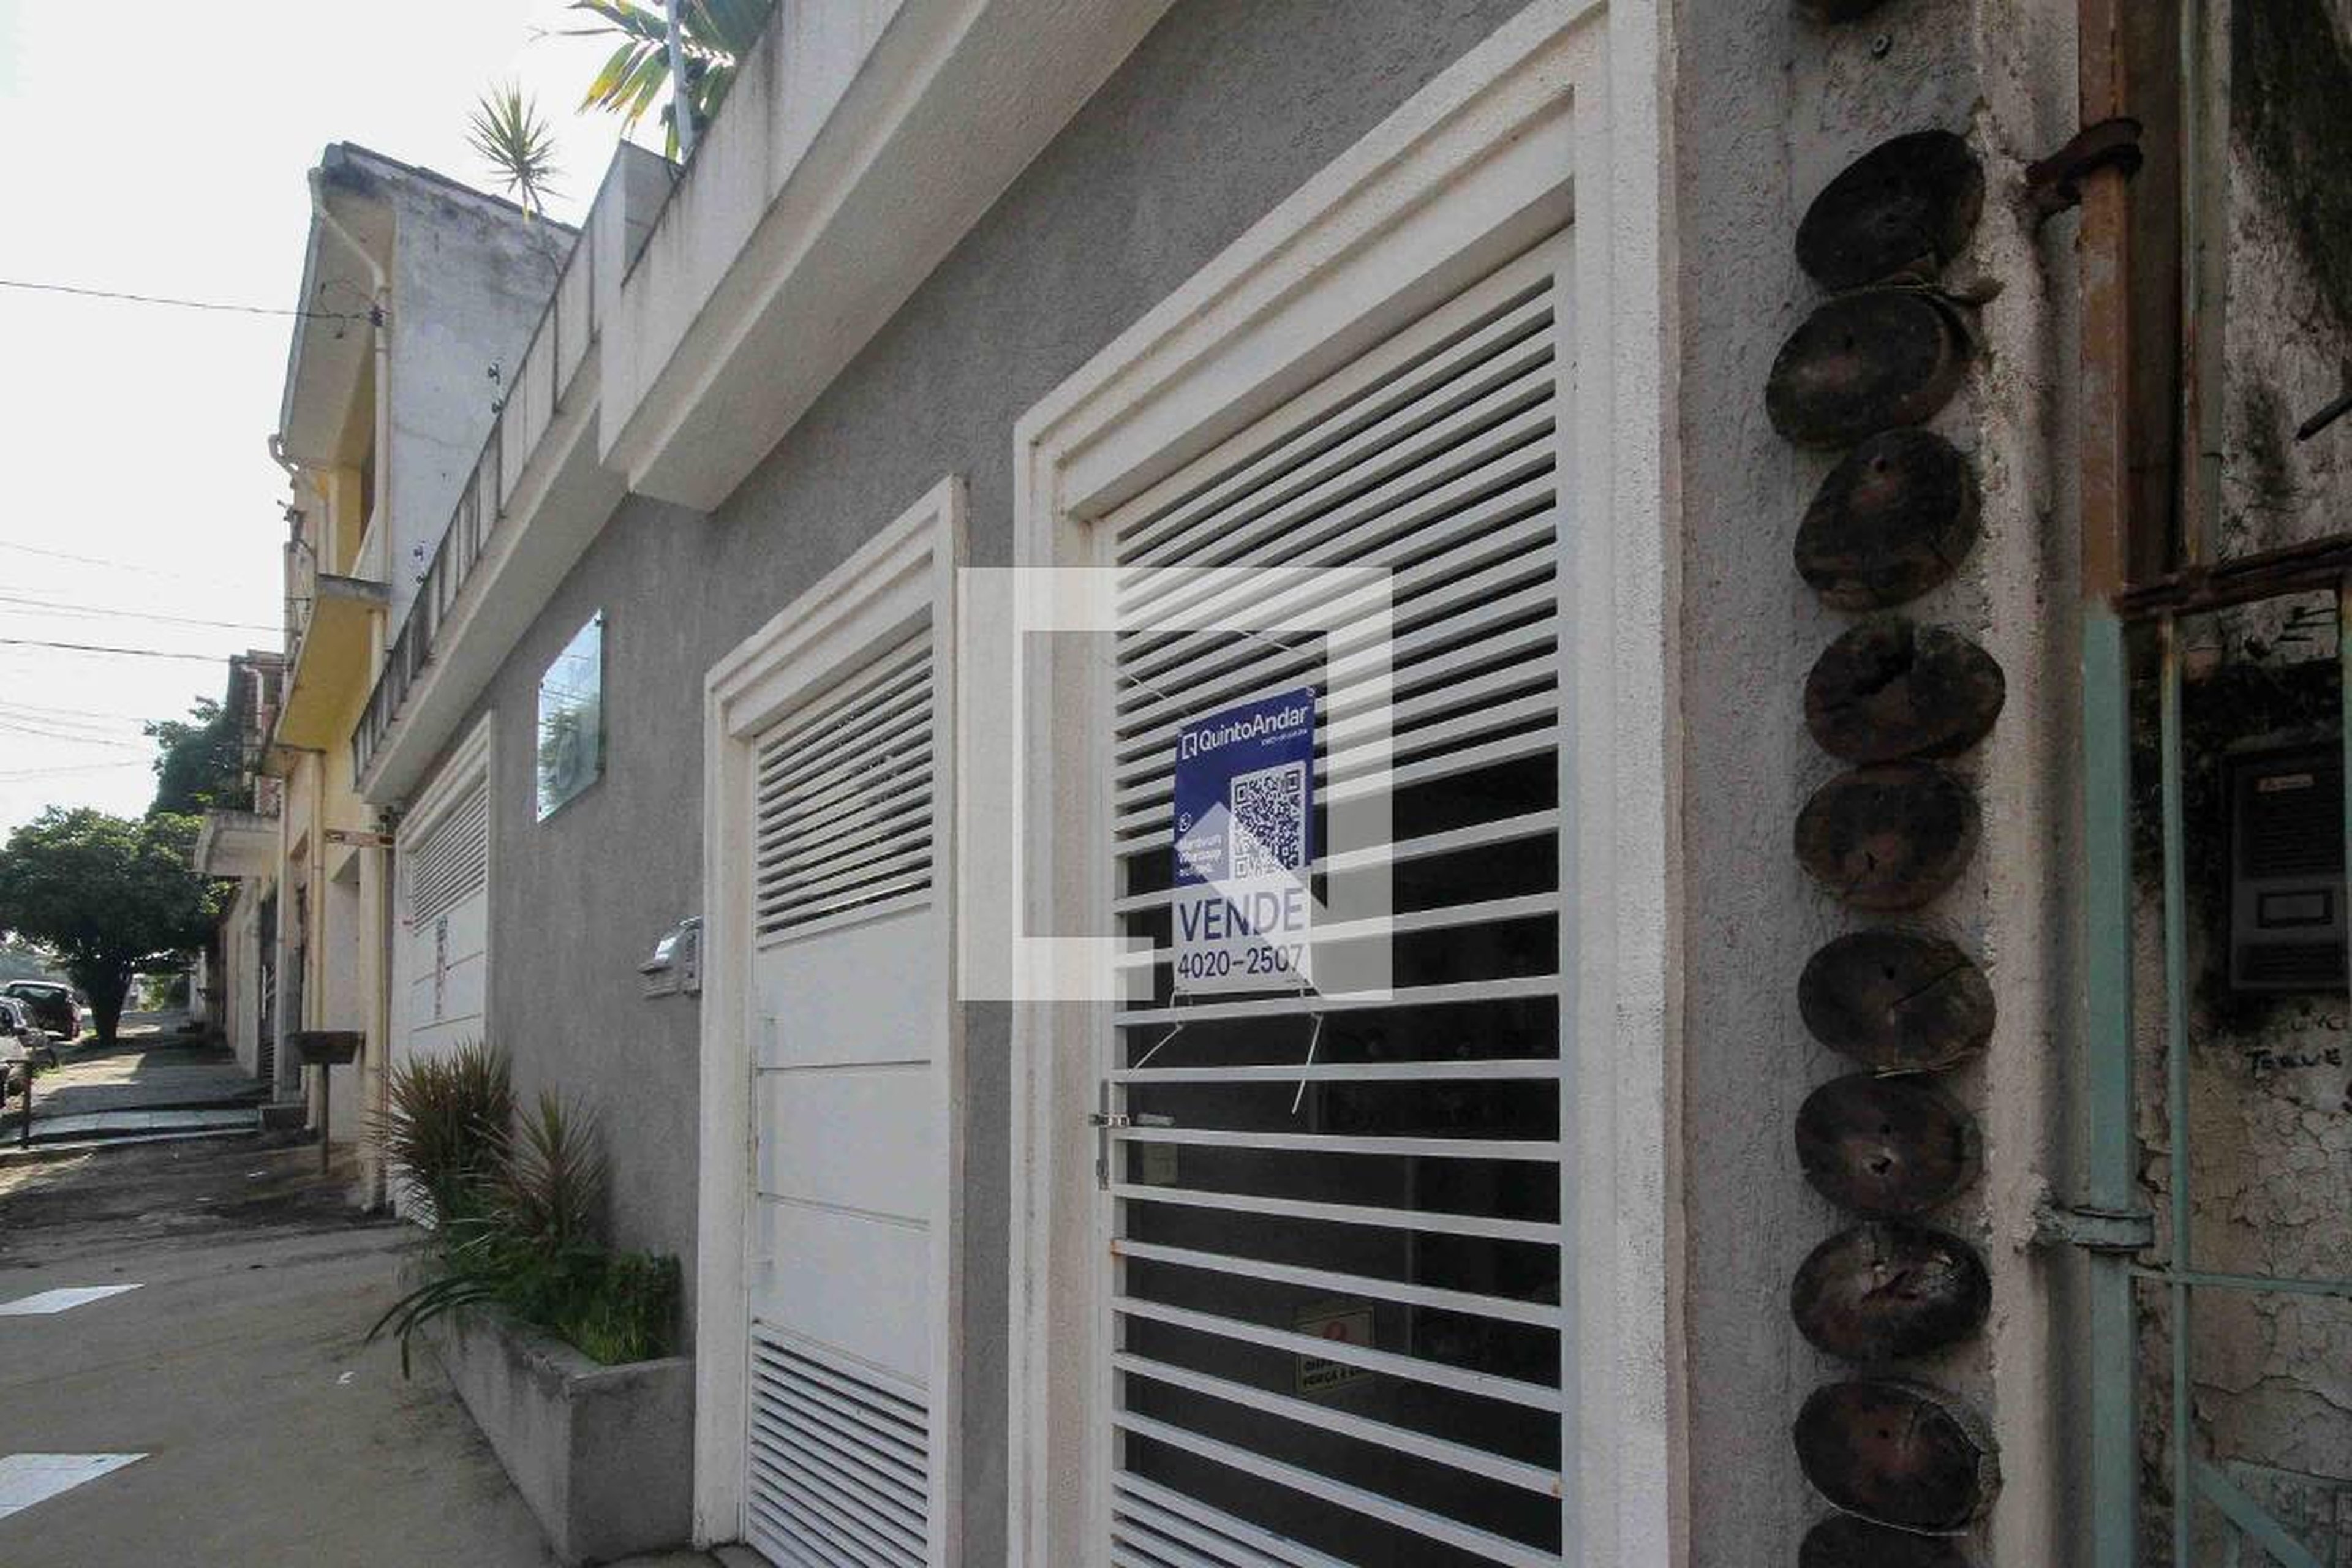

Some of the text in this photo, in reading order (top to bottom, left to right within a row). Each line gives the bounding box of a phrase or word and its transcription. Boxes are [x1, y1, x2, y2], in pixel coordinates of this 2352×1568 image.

[1199, 706, 1308, 752] QuintoAndar
[1180, 888, 1303, 941] VENDE
[1178, 944, 1302, 978] 4020-2507
